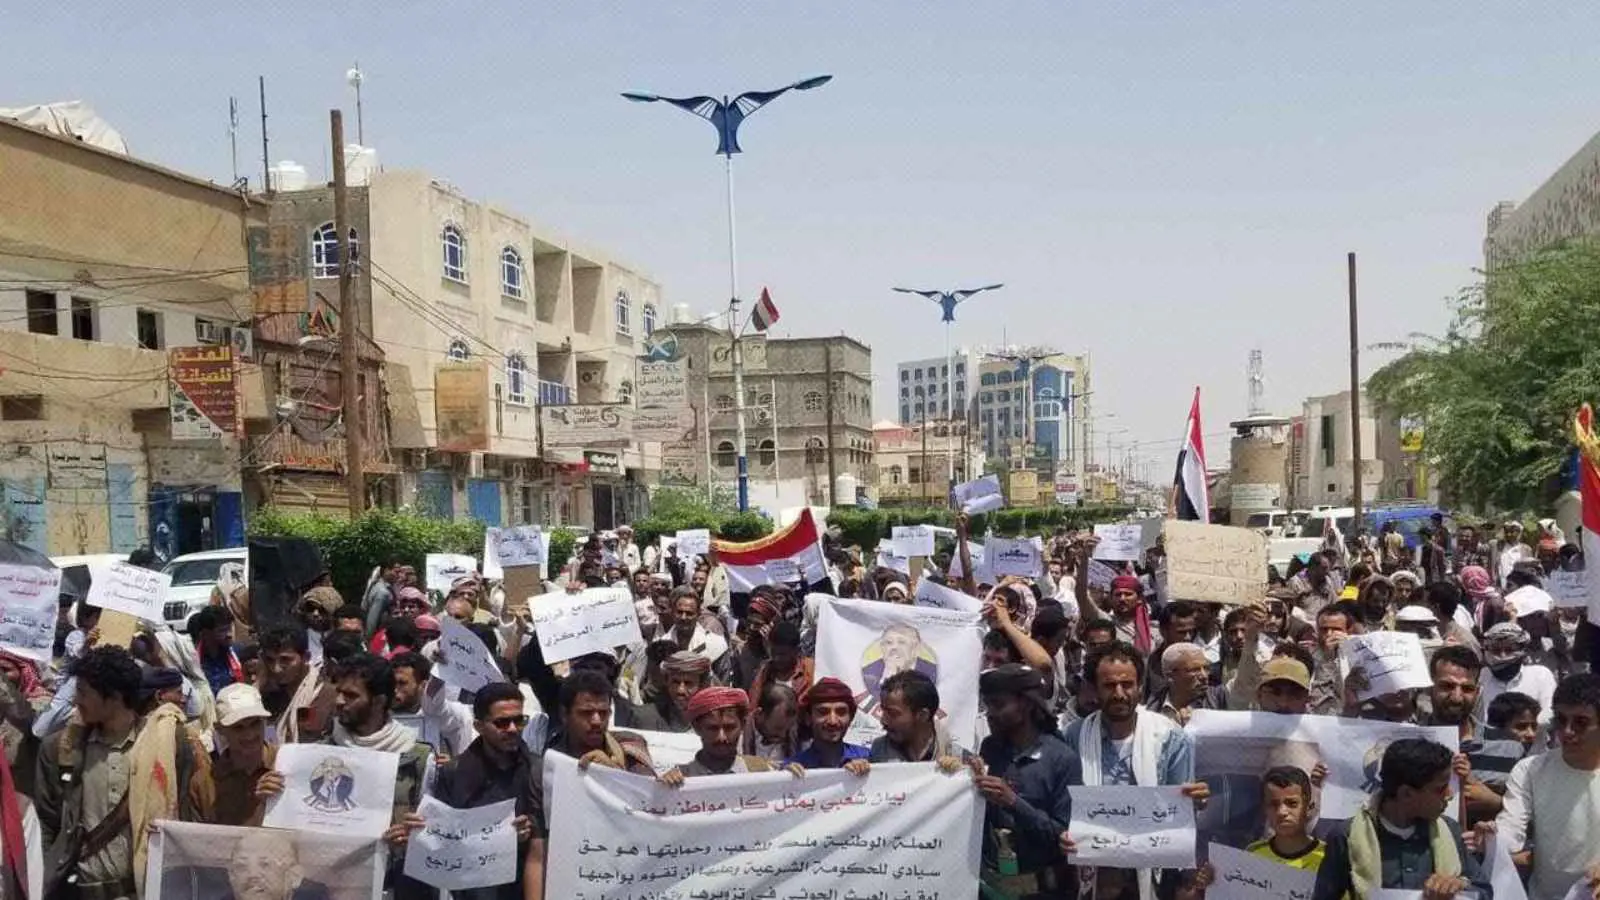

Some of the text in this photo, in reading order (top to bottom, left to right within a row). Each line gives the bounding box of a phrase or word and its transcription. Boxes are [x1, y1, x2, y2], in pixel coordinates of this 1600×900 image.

[544, 615, 632, 647] البنك المركزي
[672, 800, 726, 816] مواطن
[731, 795, 769, 814] كل
[774, 792, 816, 812] يمثل
[820, 790, 867, 812] شعبي
[578, 839, 609, 855] حق
[823, 835, 886, 850] الوطنية
[892, 836, 942, 850] العملة
[615, 846, 640, 857] هو
[648, 844, 711, 858] وحمايتها
[578, 866, 635, 884] بواجبها
[638, 865, 678, 882] تقوم
[744, 861, 809, 877] الشرعية
[813, 861, 888, 876] للحكومة
[892, 865, 941, 880] سيادي
